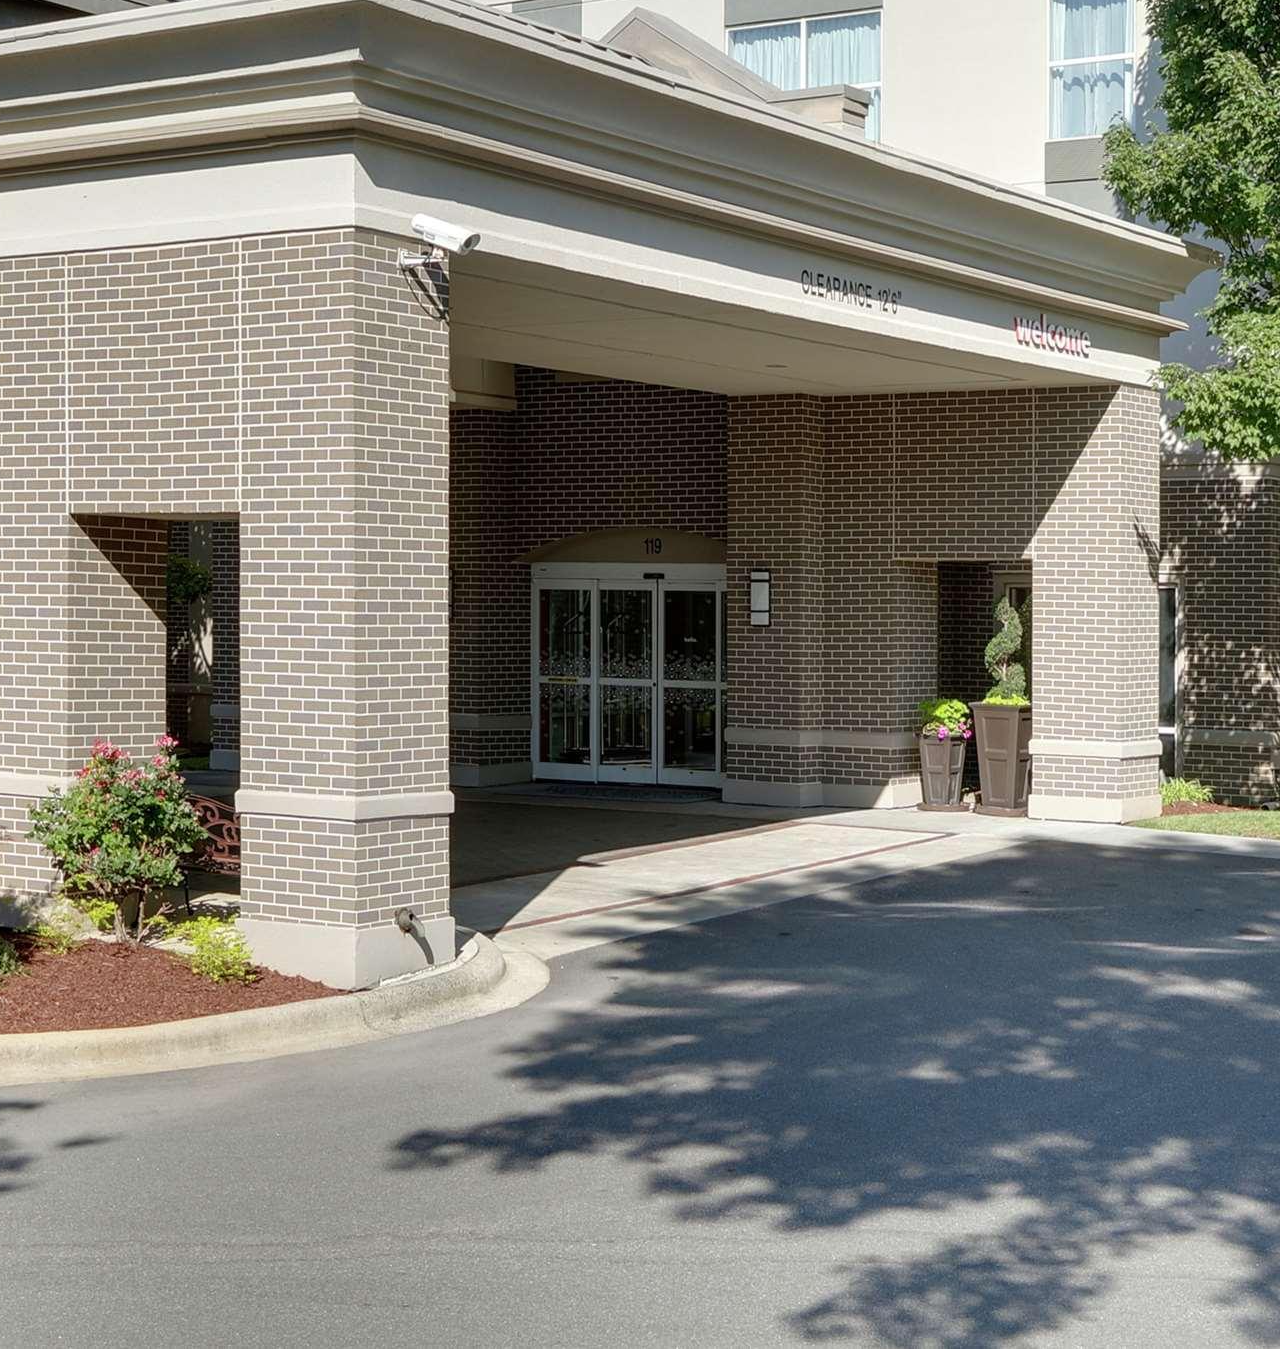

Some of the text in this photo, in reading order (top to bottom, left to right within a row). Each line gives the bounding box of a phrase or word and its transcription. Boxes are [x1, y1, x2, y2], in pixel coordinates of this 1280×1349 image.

[801, 269, 872, 308] CLEARANCE
[1013, 313, 1091, 358] welcome
[644, 537, 662, 555] 119
